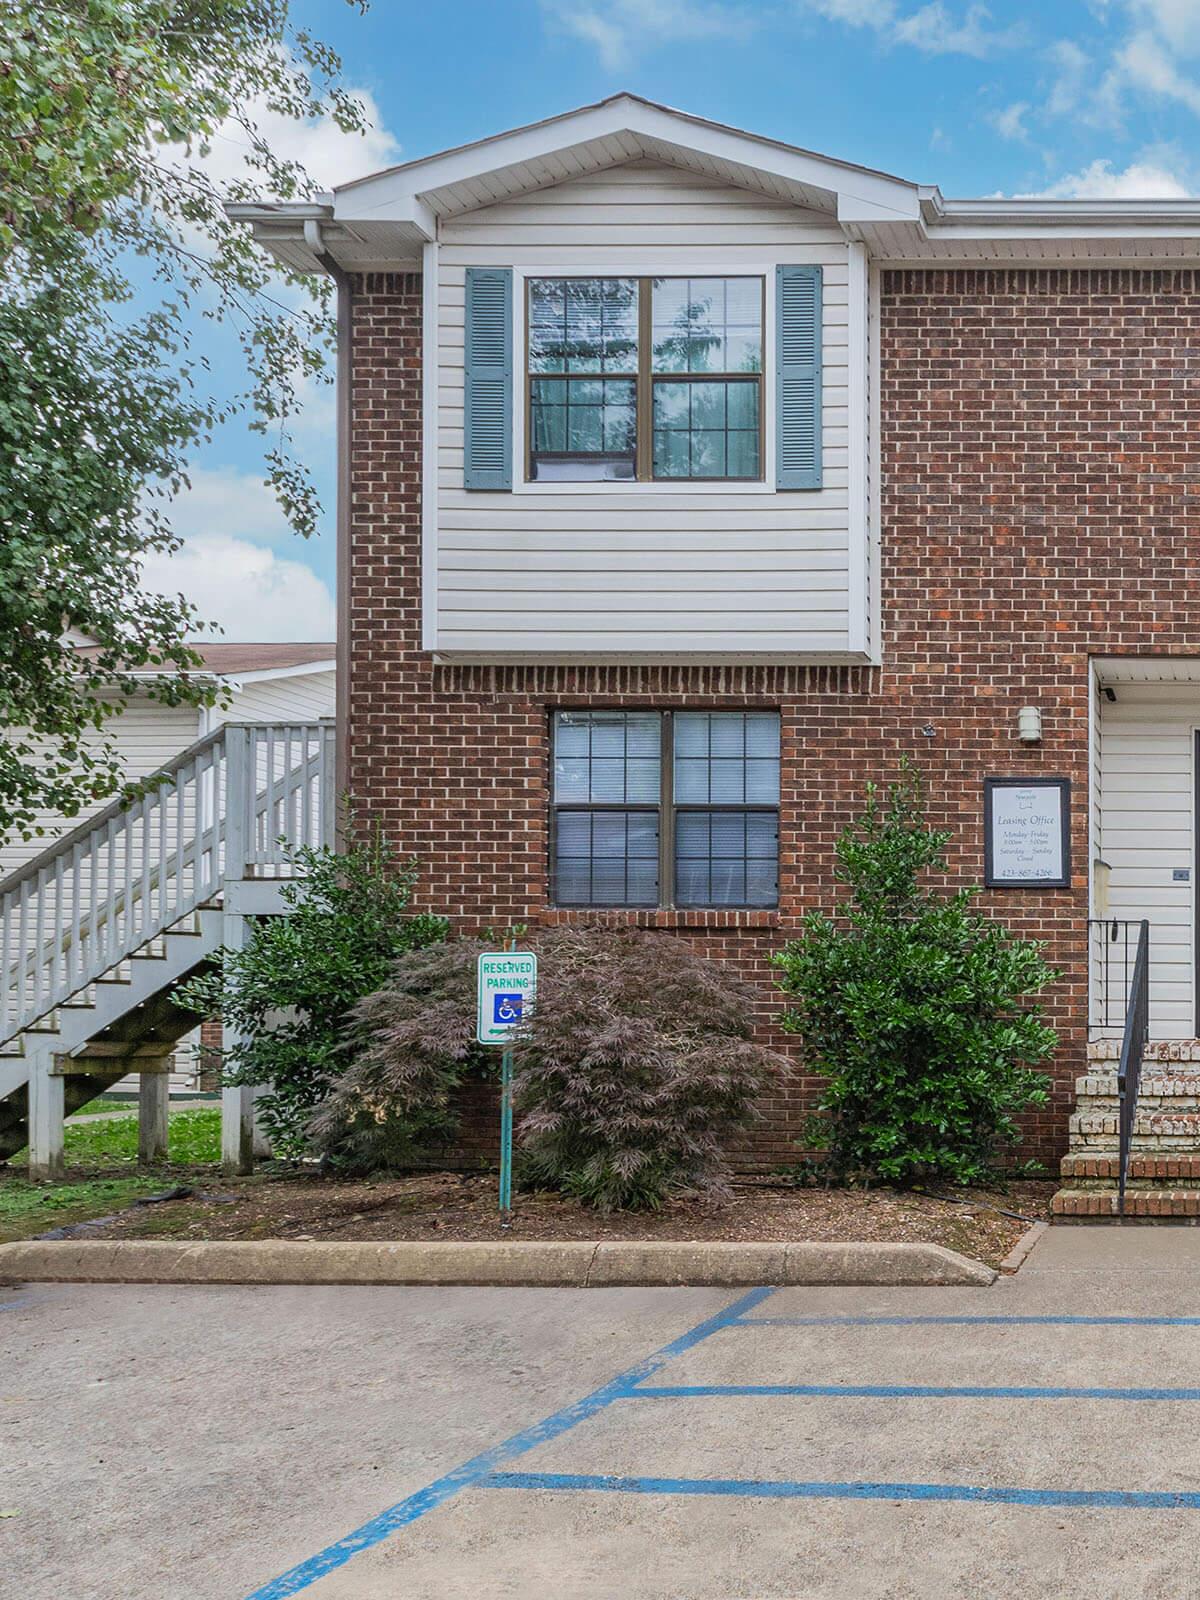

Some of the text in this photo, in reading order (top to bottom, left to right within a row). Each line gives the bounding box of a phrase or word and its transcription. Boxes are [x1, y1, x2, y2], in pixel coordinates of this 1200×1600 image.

[998, 815, 1054, 826] Leasing Office
[484, 963, 532, 973] RESERVED
[487, 978, 529, 988] PARKING
